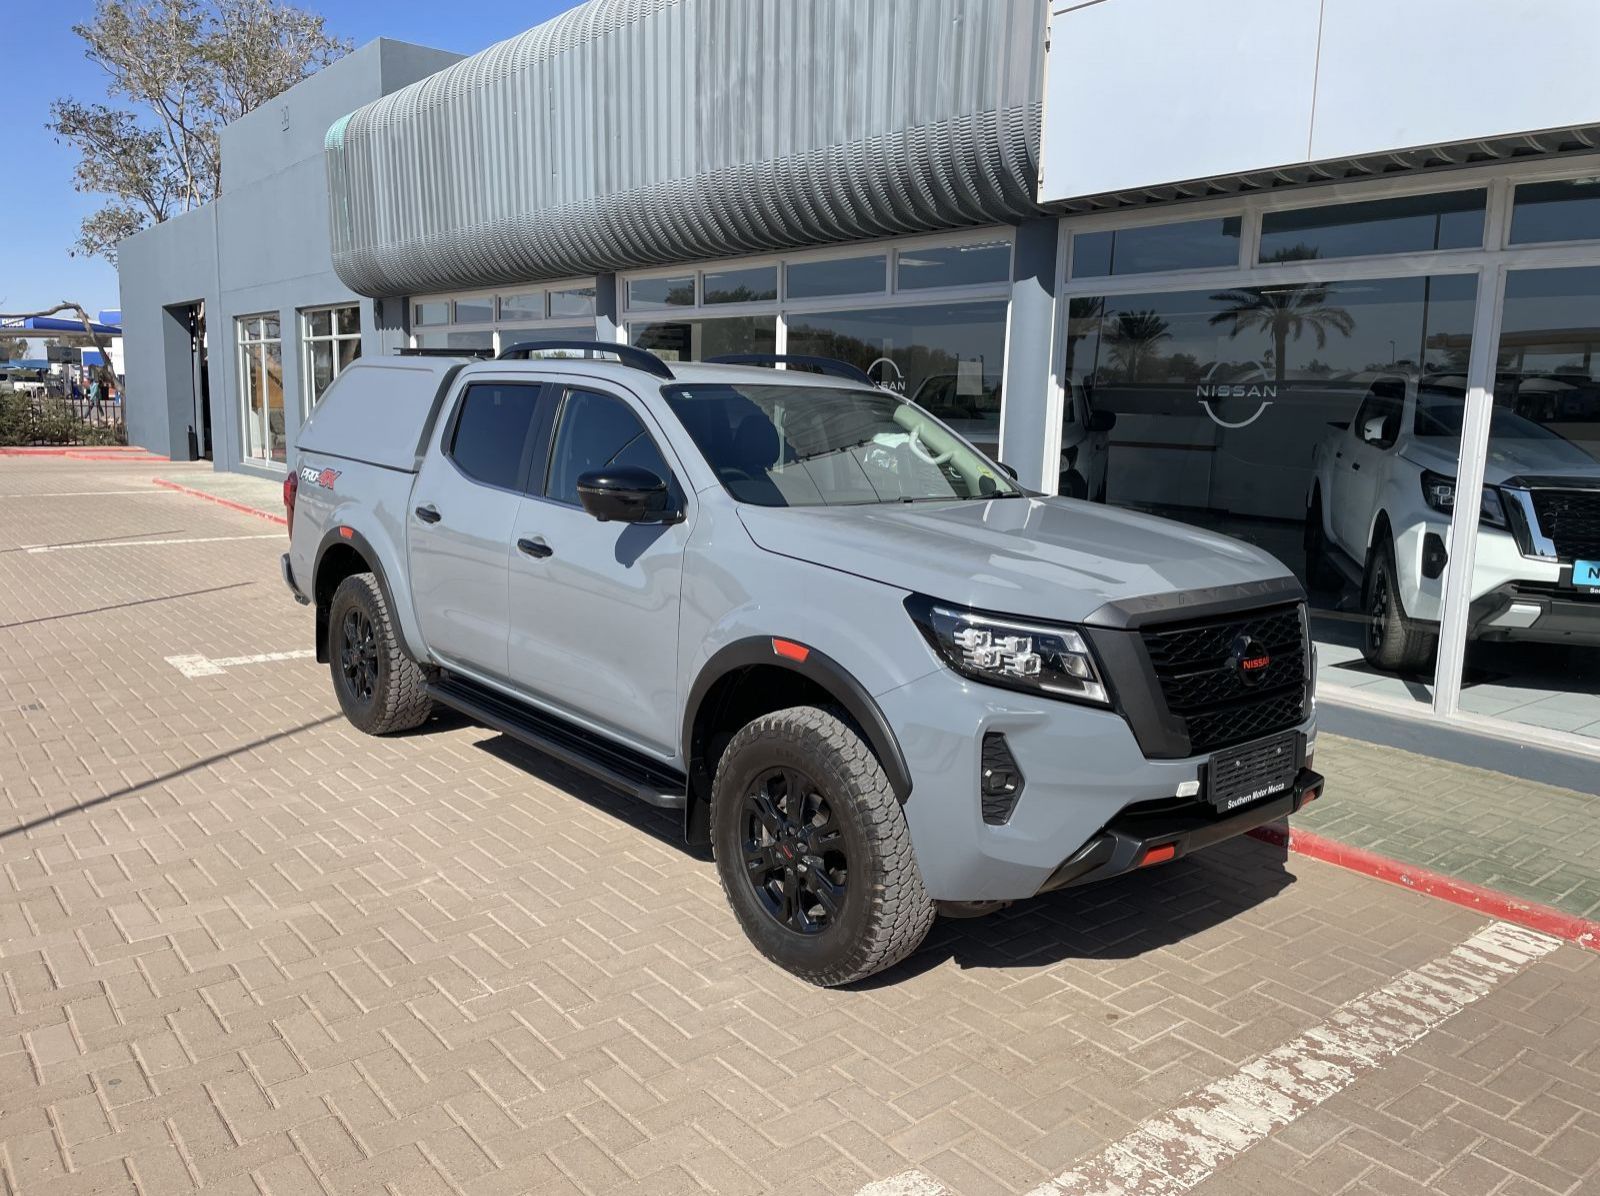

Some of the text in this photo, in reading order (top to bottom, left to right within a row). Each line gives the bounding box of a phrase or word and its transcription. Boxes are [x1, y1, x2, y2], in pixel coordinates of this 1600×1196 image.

[1196, 385, 1277, 397] NISSAN
[1227, 782, 1285, 809] Southern Motor Mecca
